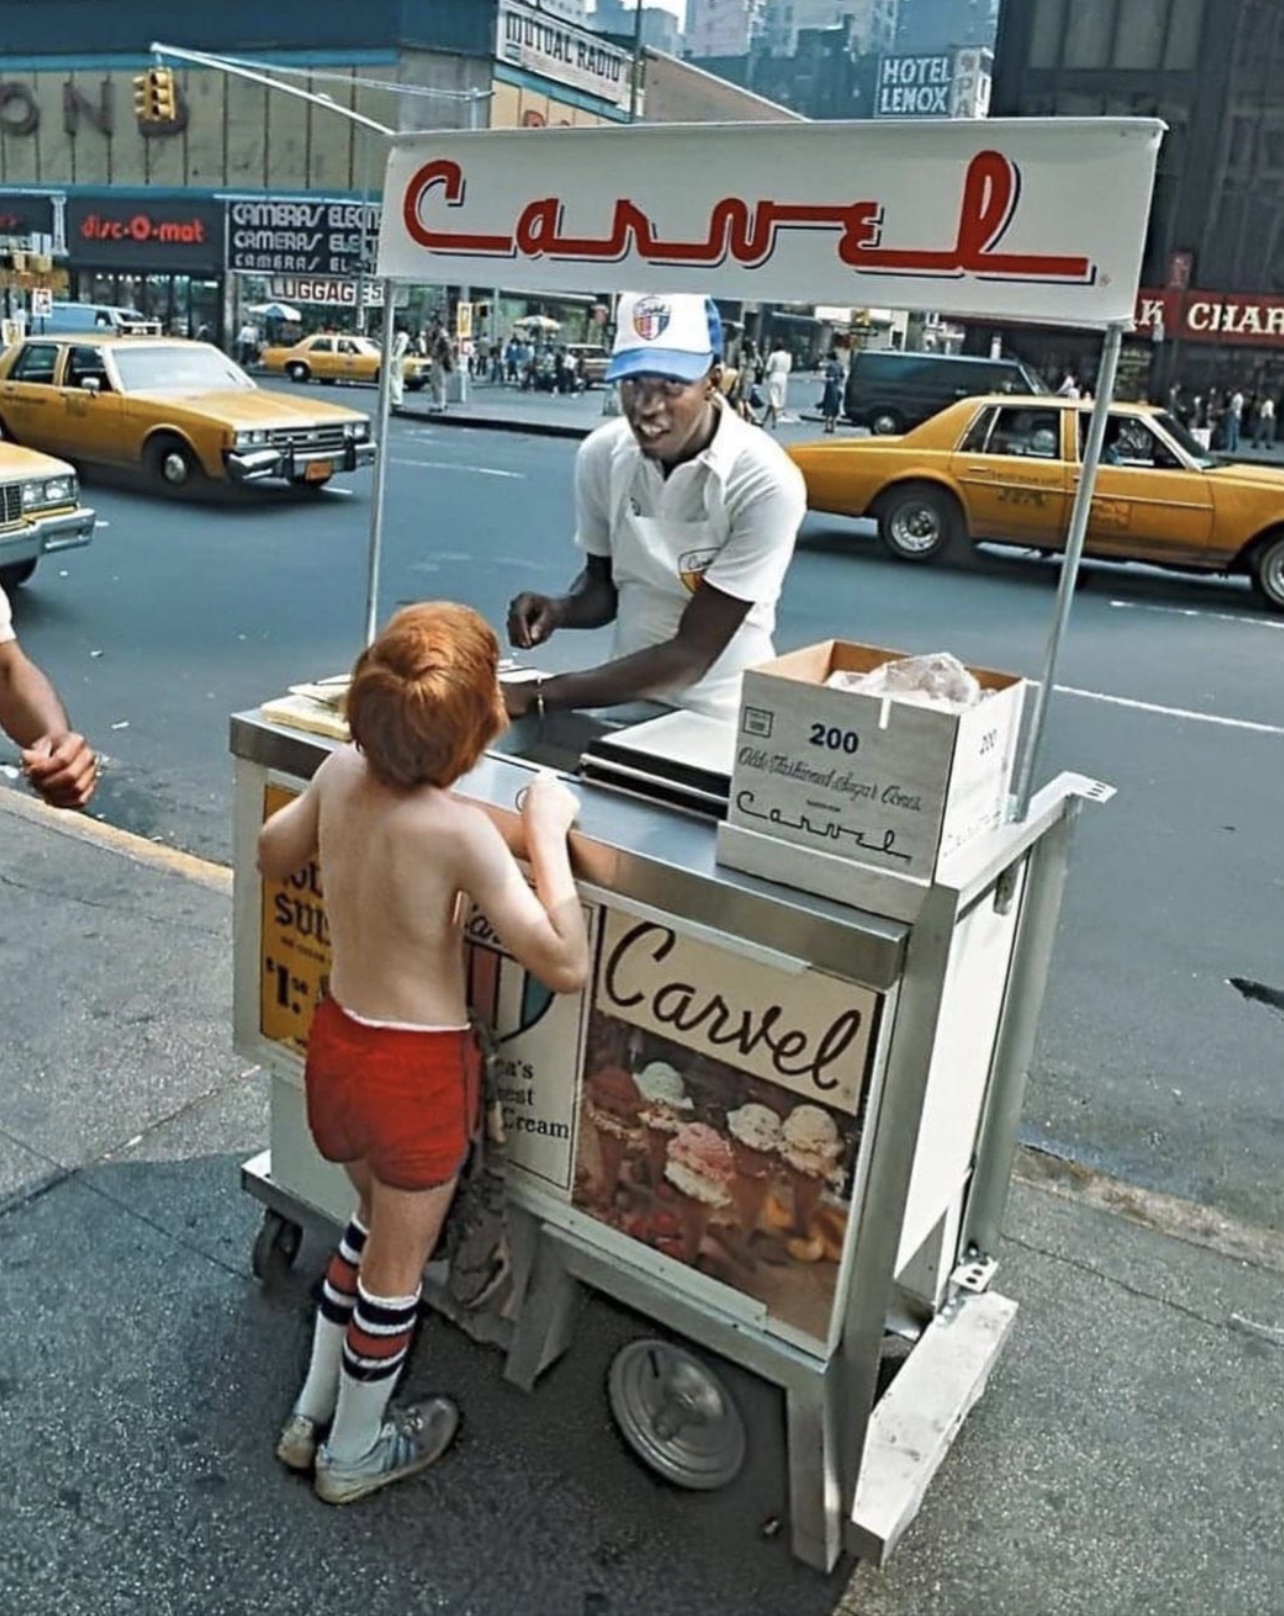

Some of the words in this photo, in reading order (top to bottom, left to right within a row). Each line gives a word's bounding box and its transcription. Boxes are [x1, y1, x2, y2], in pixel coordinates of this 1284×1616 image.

[505, 11, 573, 63] MUTUAL
[576, 41, 622, 82] RADIO
[882, 57, 952, 84] HOTEL
[881, 86, 949, 113] LENOX
[232, 203, 325, 227] CAMERAS
[403, 150, 1095, 285] Carvel
[233, 229, 324, 250] CAMERAS
[234, 252, 321, 271] CAMERAS
[809, 722, 859, 754] 200
[736, 791, 911, 862] Carvel
[604, 921, 862, 1090] Carvel
